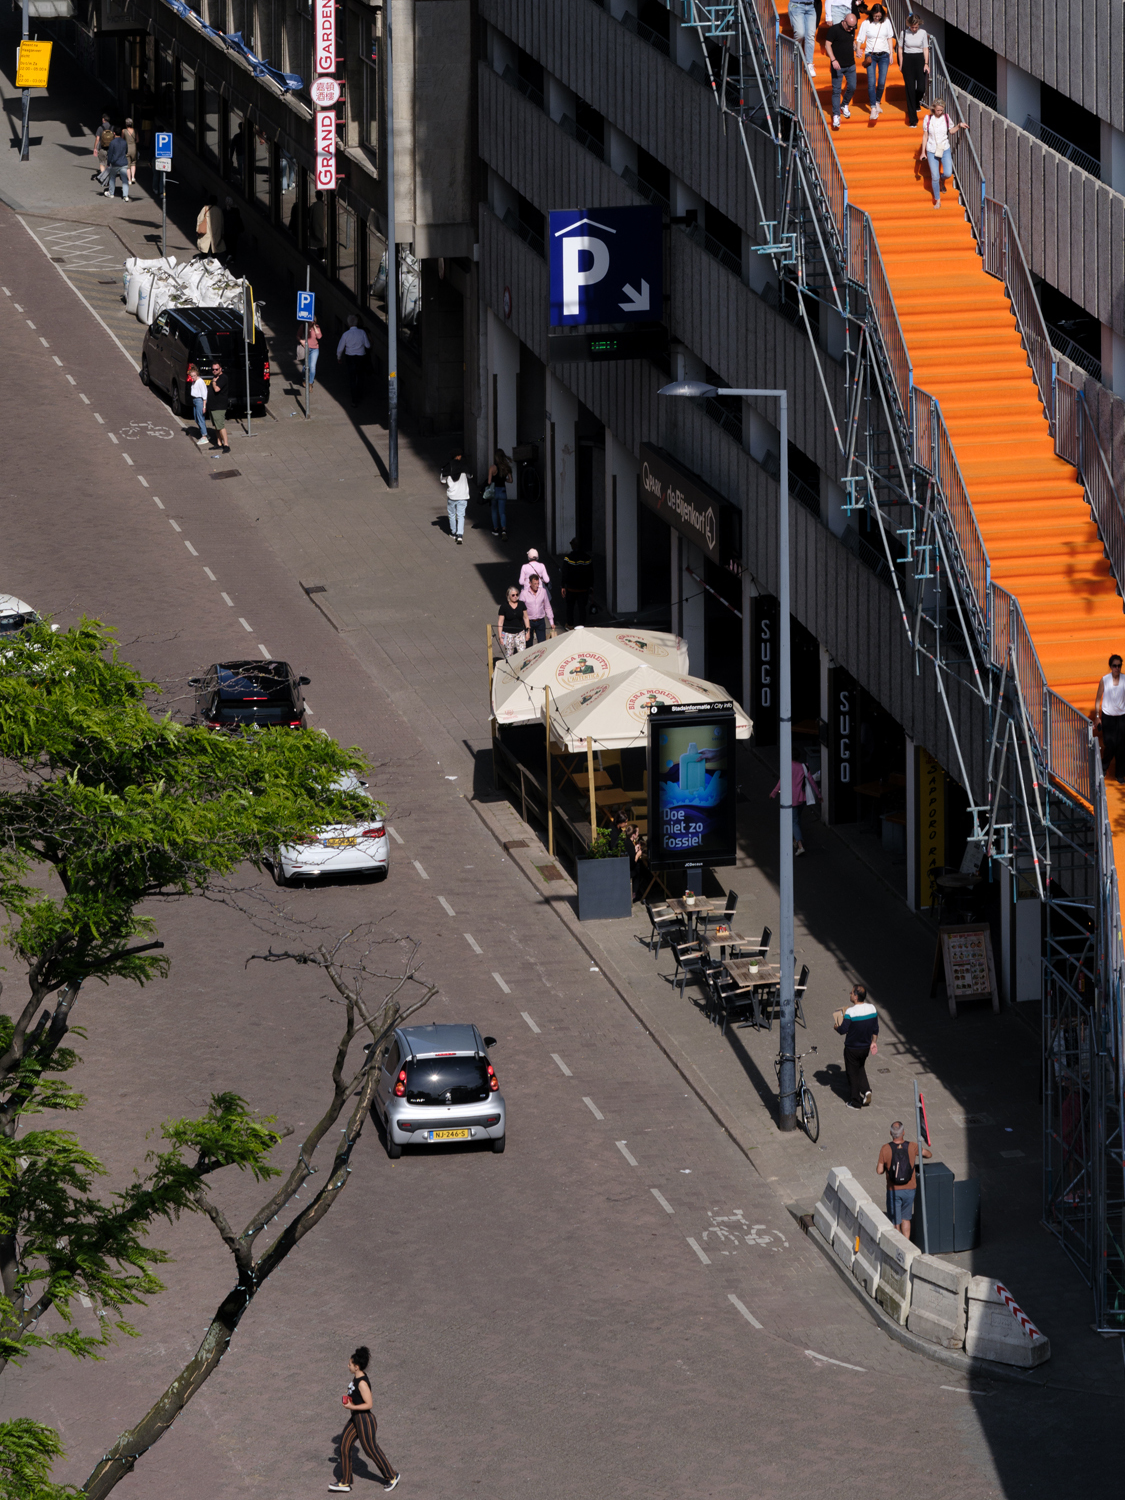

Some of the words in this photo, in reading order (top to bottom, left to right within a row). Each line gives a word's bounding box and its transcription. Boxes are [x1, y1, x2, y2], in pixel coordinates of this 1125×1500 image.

[159, 135, 168, 147] P
[318, 116, 332, 185] GRAND
[563, 237, 610, 315] P
[301, 294, 310, 308] P
[558, 656, 576, 676] BIRRA
[578, 653, 608, 670] MORETTI
[761, 620, 771, 707] SUGO
[629, 692, 645, 710] BIRRA
[646, 689, 679, 704] MORETT
[840, 691, 849, 782] SUGO
[664, 808, 685, 820] Doe
[927, 765, 937, 840] SAPPORO
[664, 821, 686, 833] niet
[689, 822, 703, 832] zo
